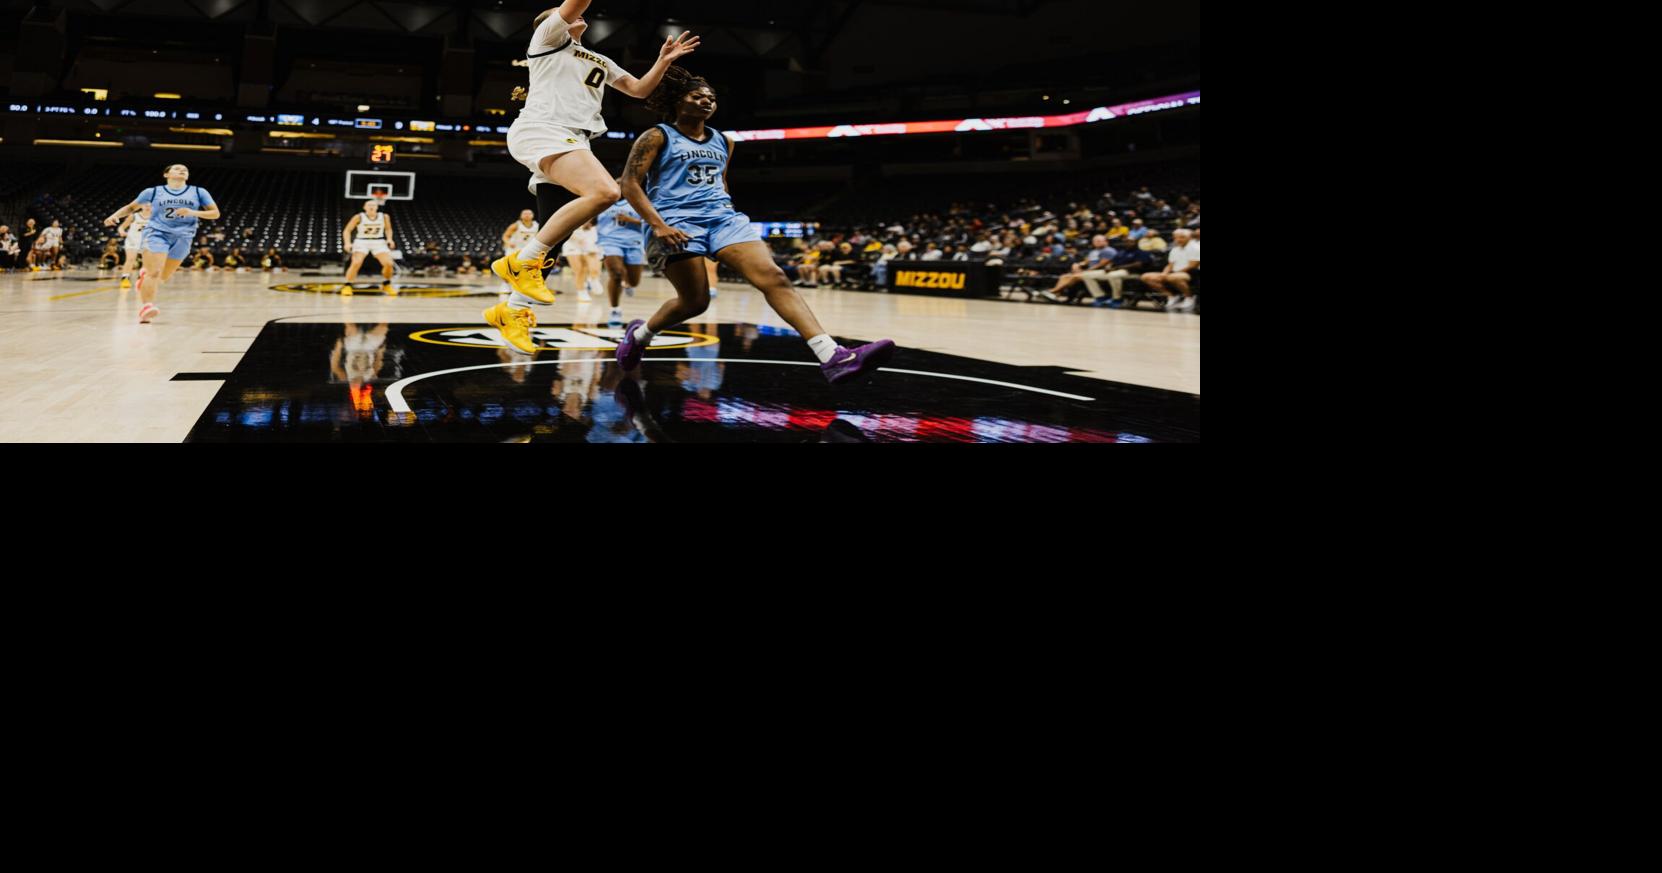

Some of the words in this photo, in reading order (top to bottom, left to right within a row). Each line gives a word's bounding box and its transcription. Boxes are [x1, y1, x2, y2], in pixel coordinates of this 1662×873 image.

[585, 67, 605, 88] 0
[371, 150, 391, 162] 27
[687, 164, 718, 185] 35
[895, 271, 965, 289] MIZZOU
